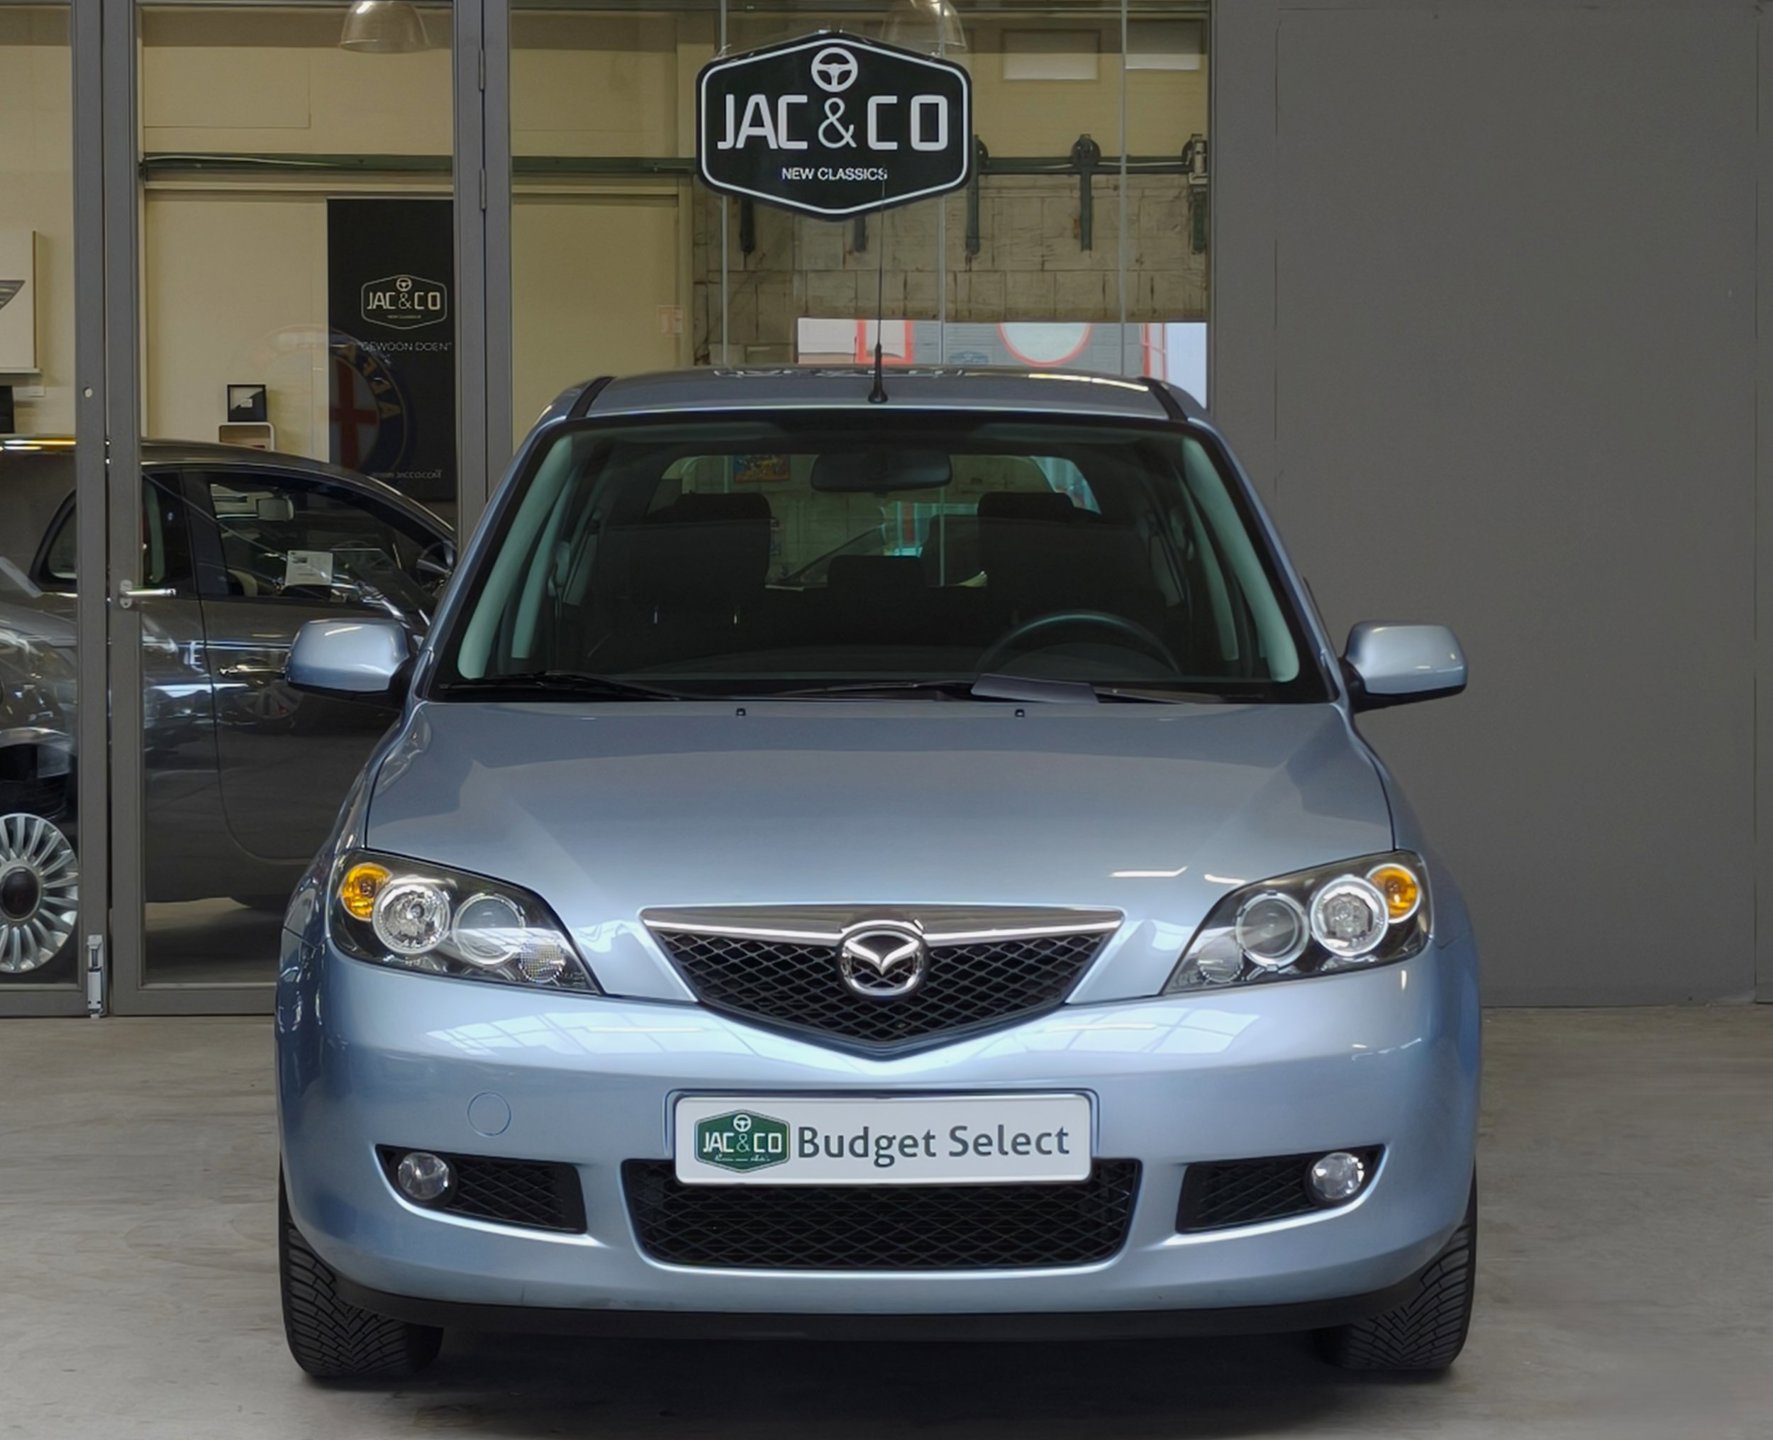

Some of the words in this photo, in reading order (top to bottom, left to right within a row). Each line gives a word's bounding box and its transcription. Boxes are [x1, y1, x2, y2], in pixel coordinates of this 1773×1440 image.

[781, 167, 814, 180] NEW
[817, 167, 888, 180] CLASSICS
[798, 1126, 937, 1168] Budget
[948, 1124, 1070, 1157] Select
